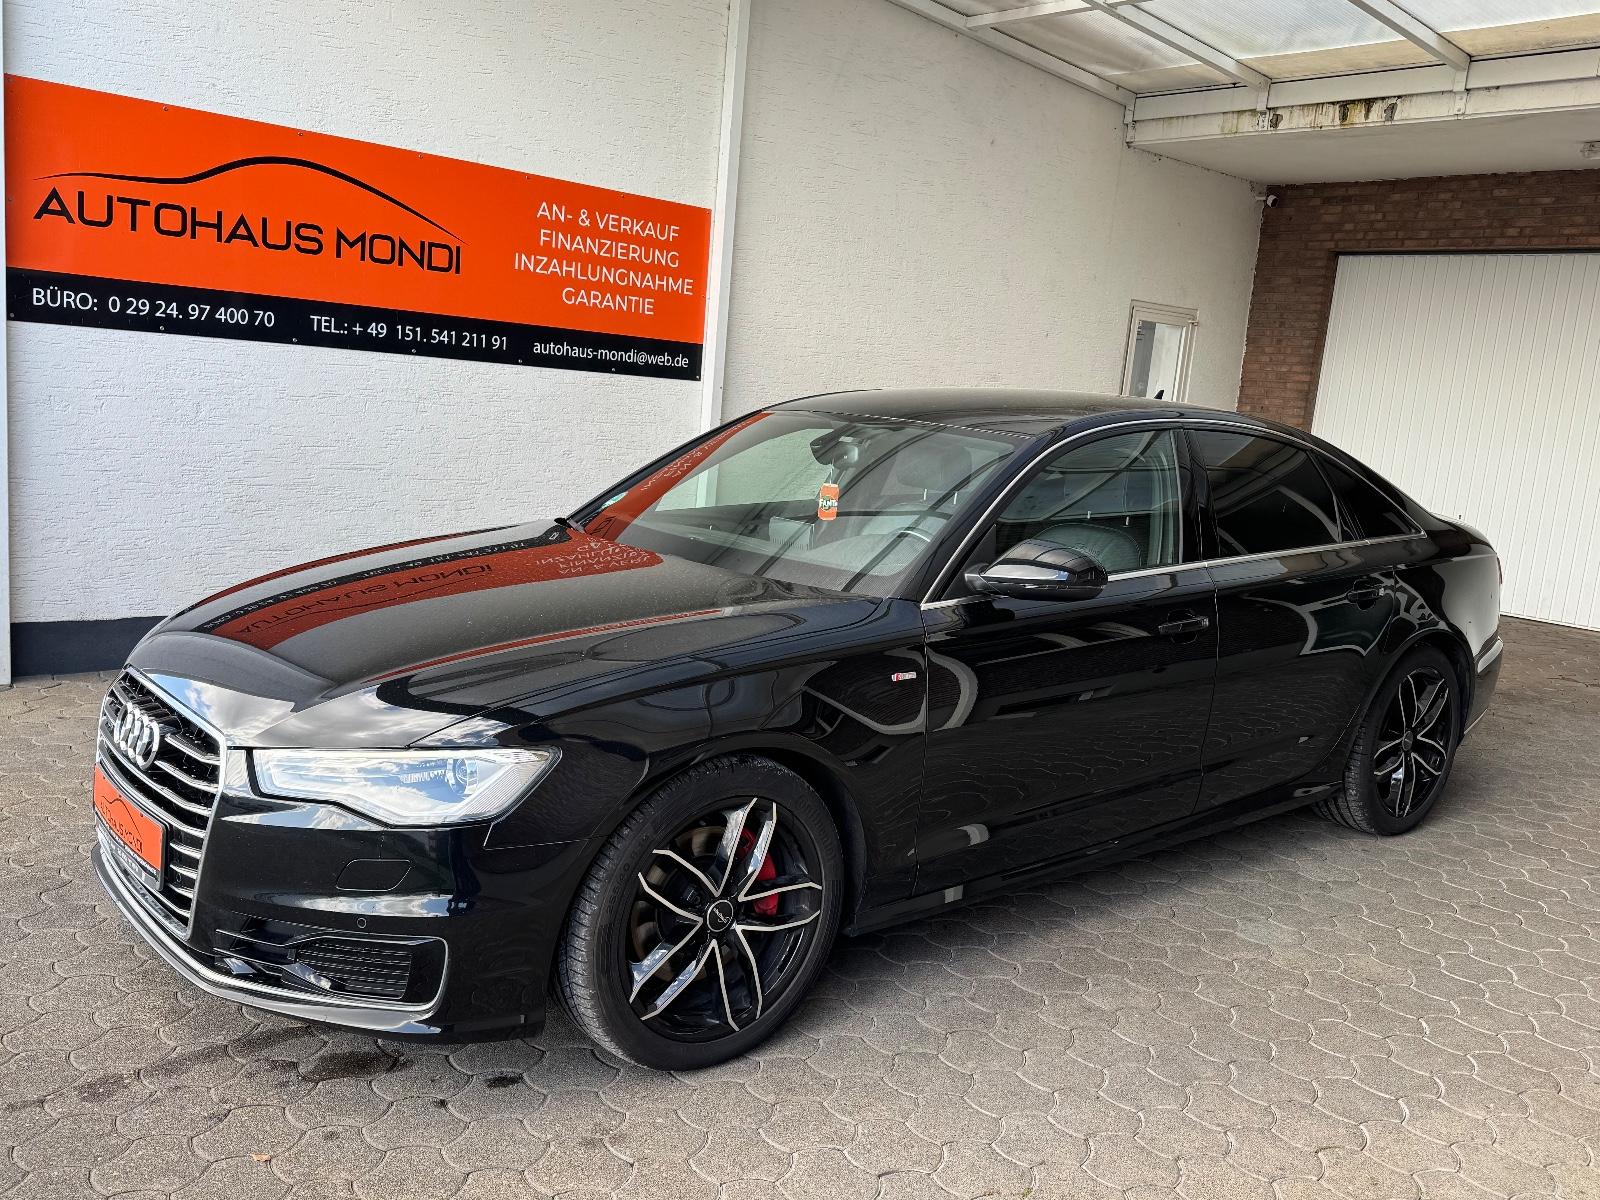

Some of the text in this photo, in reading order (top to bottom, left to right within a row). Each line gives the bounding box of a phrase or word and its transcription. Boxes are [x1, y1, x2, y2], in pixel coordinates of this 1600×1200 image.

[33, 187, 461, 275] AUTOHAUS MONDI
[537, 202, 680, 242] AN- & VERKAUF
[540, 229, 679, 268] FINANZIERUNG
[514, 253, 694, 296] INZAHLUNGNAHME
[32, 285, 275, 328] BÜRO: 0 29 24. 97 400 70
[562, 287, 655, 315] GARANTIE
[309, 315, 507, 351] TEL.: + 49 151. 541 211 91
[533, 341, 689, 368] autohaus-mondi@web.de
